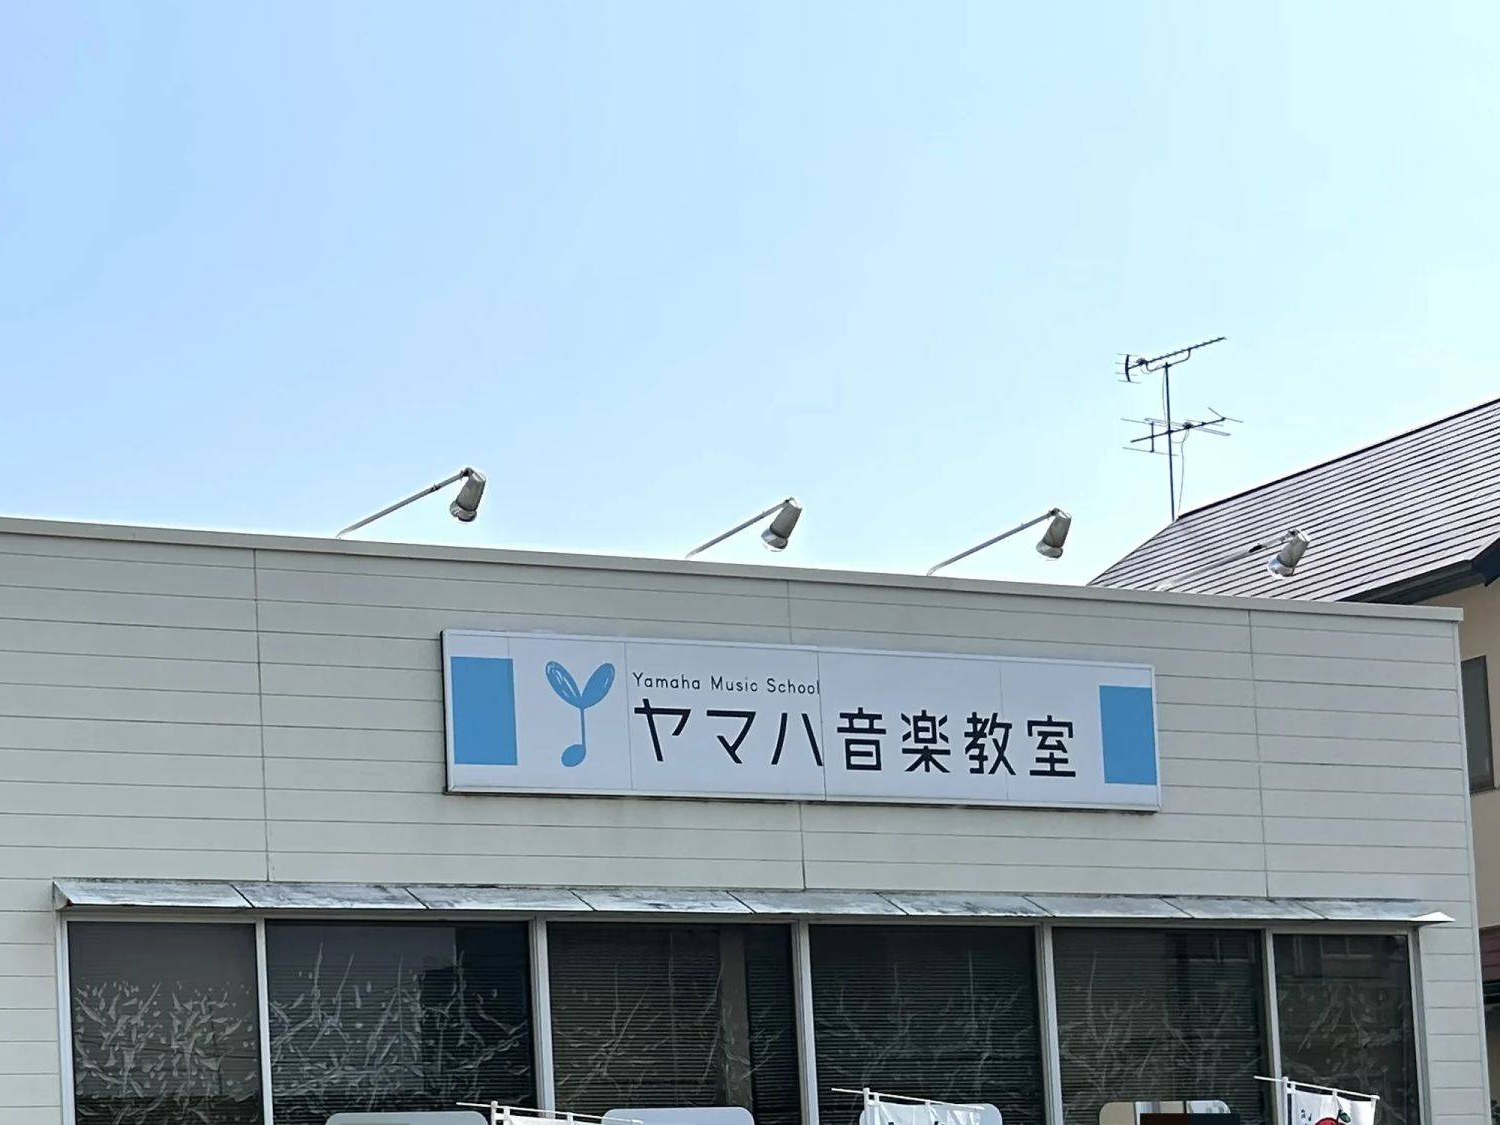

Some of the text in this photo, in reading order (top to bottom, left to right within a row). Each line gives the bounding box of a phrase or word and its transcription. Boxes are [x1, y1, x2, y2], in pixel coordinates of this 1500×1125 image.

[632, 671, 820, 695] Yamaha Music School
[633, 697, 1077, 778] ヤマハ音楽教室
